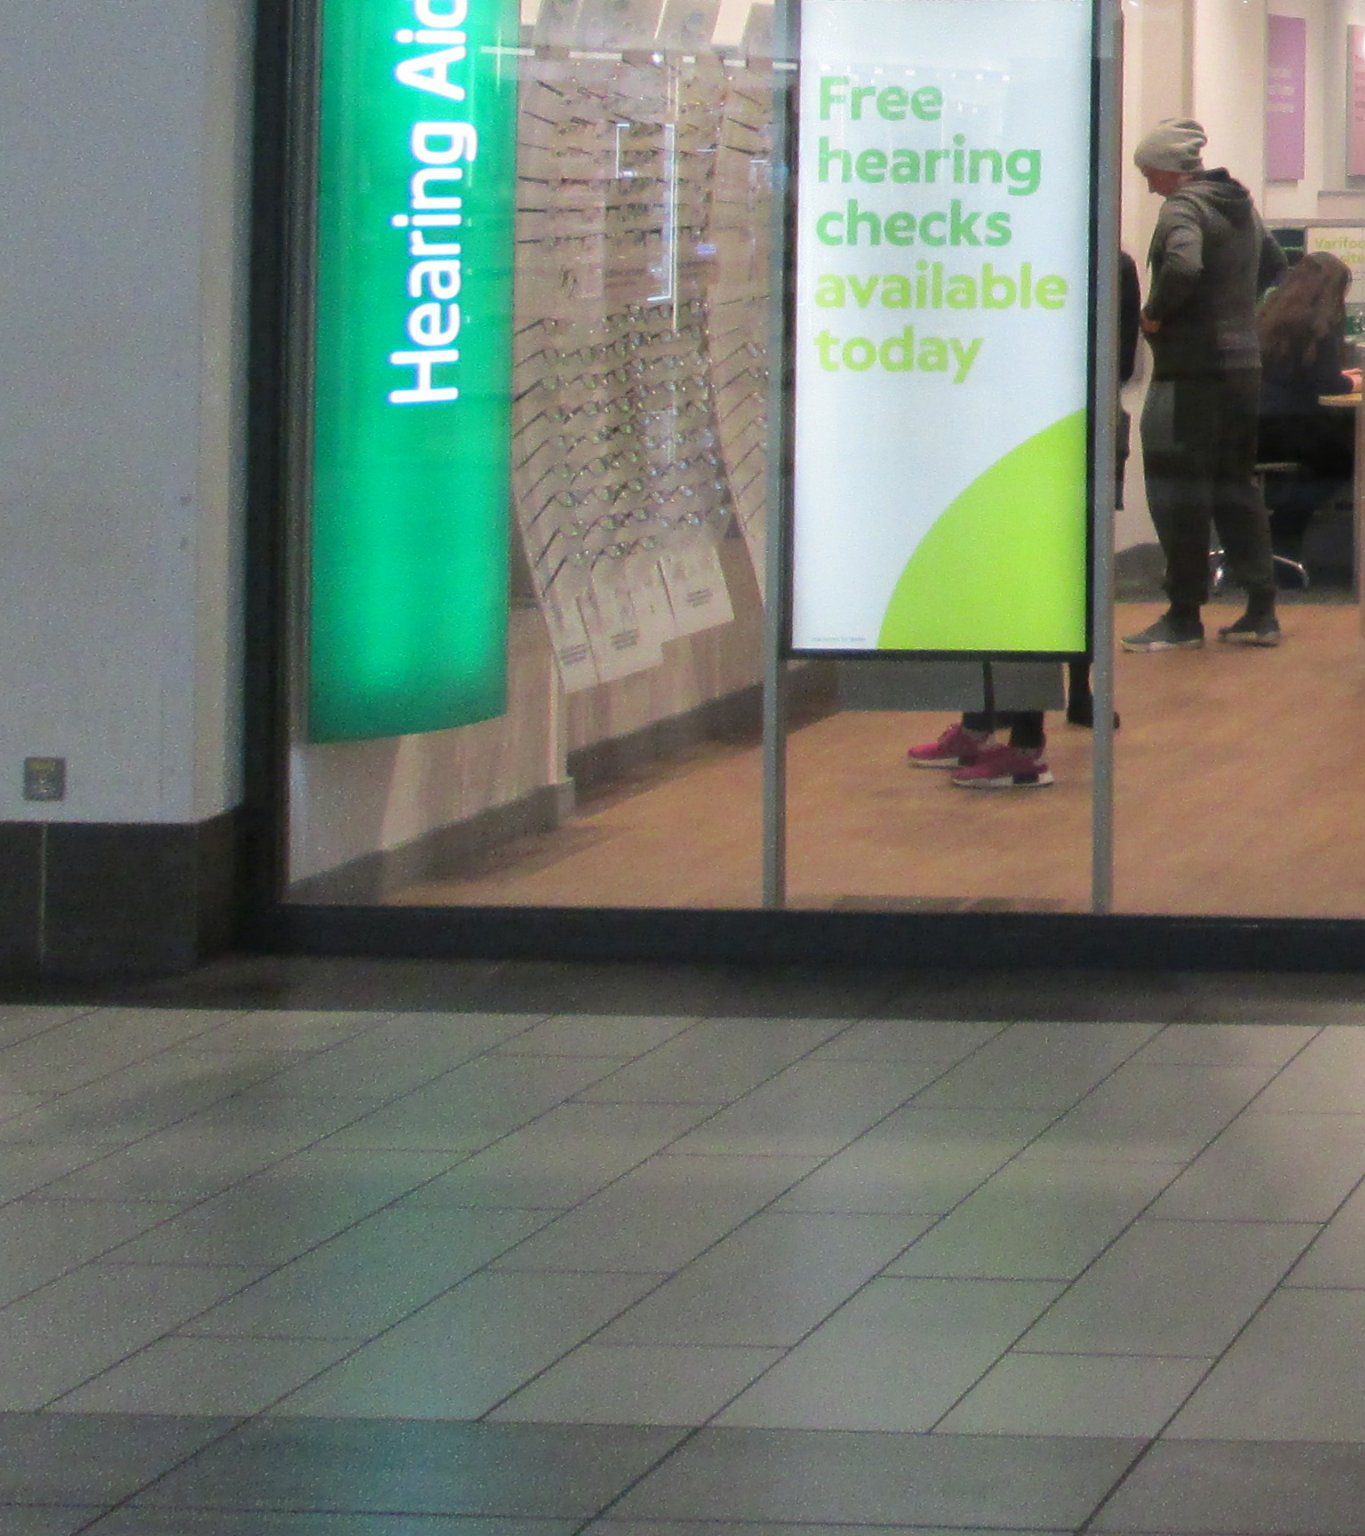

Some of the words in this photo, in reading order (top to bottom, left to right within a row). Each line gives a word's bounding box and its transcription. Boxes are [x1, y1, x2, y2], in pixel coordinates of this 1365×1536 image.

[818, 75, 943, 122] Free
[817, 132, 1042, 197] hearing
[815, 199, 1013, 247] checks
[387, 121, 478, 406] Hearing
[814, 258, 1069, 310] available
[813, 324, 985, 385] today
